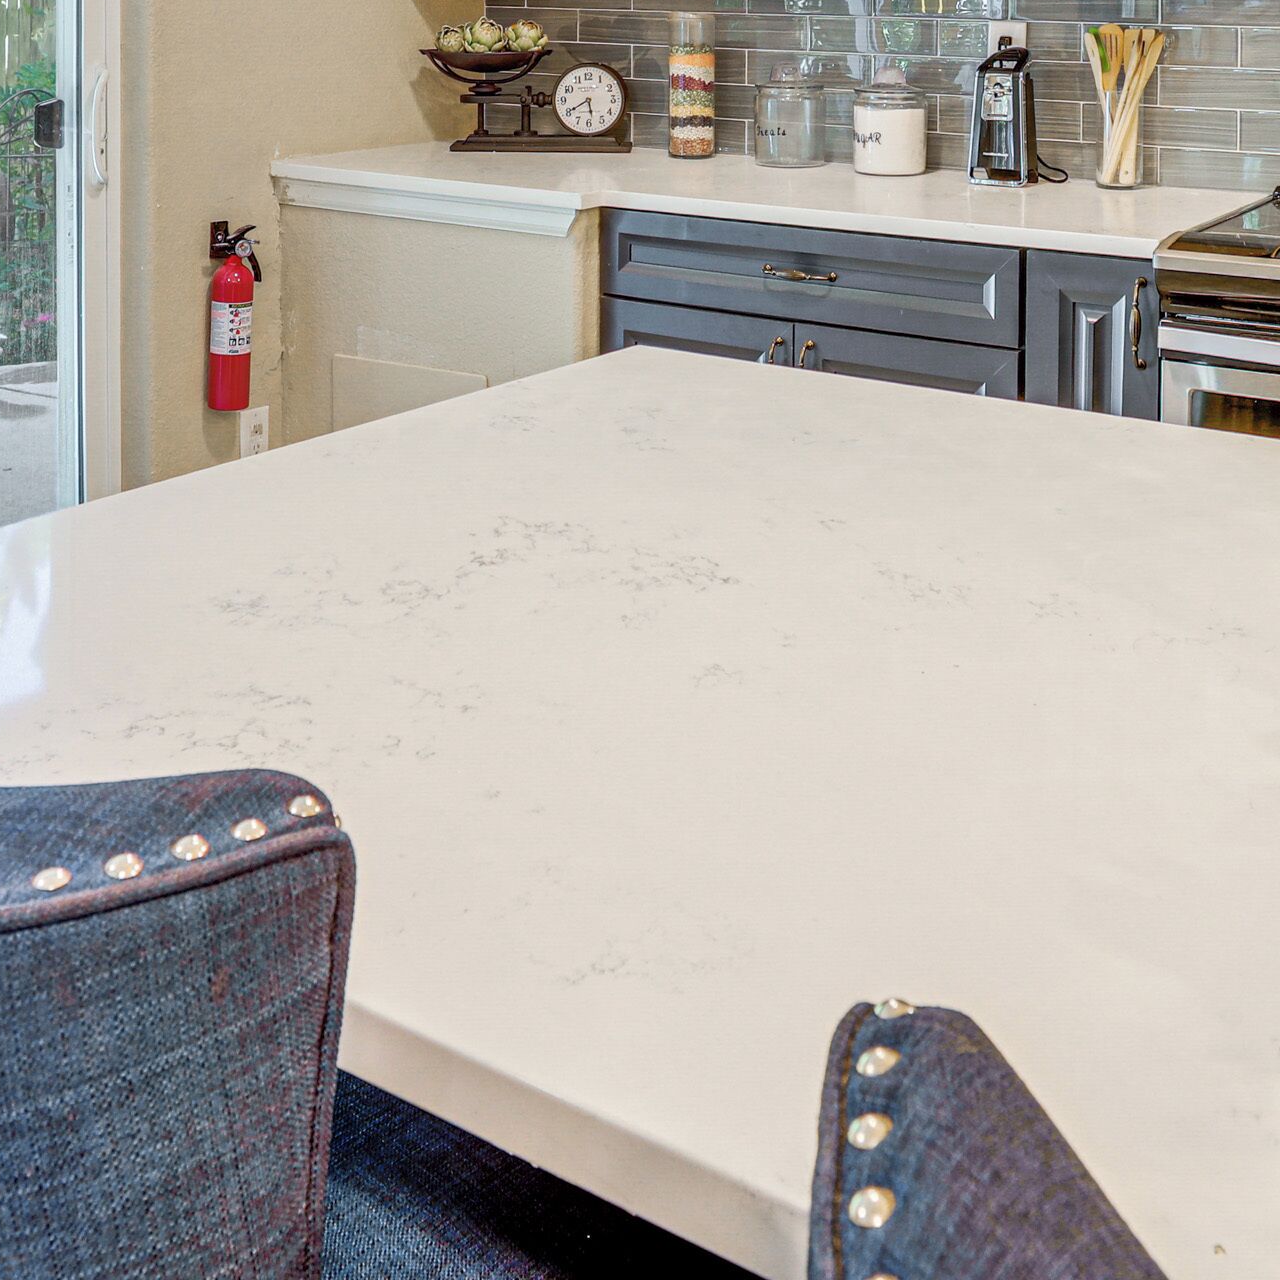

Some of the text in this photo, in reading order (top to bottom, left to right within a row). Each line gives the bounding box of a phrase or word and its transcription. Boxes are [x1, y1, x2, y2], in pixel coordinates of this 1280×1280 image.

[574, 75, 581, 84] 11
[584, 72, 593, 81] 12
[564, 85, 573, 94] 10
[606, 84, 613, 92] 2
[560, 96, 567, 105] 9
[610, 95, 616, 104] 3
[565, 107, 572, 117] 8
[606, 107, 612, 116] 4
[575, 116, 581, 125] 7
[586, 119, 592, 128] 6
[599, 115, 605, 124] 5
